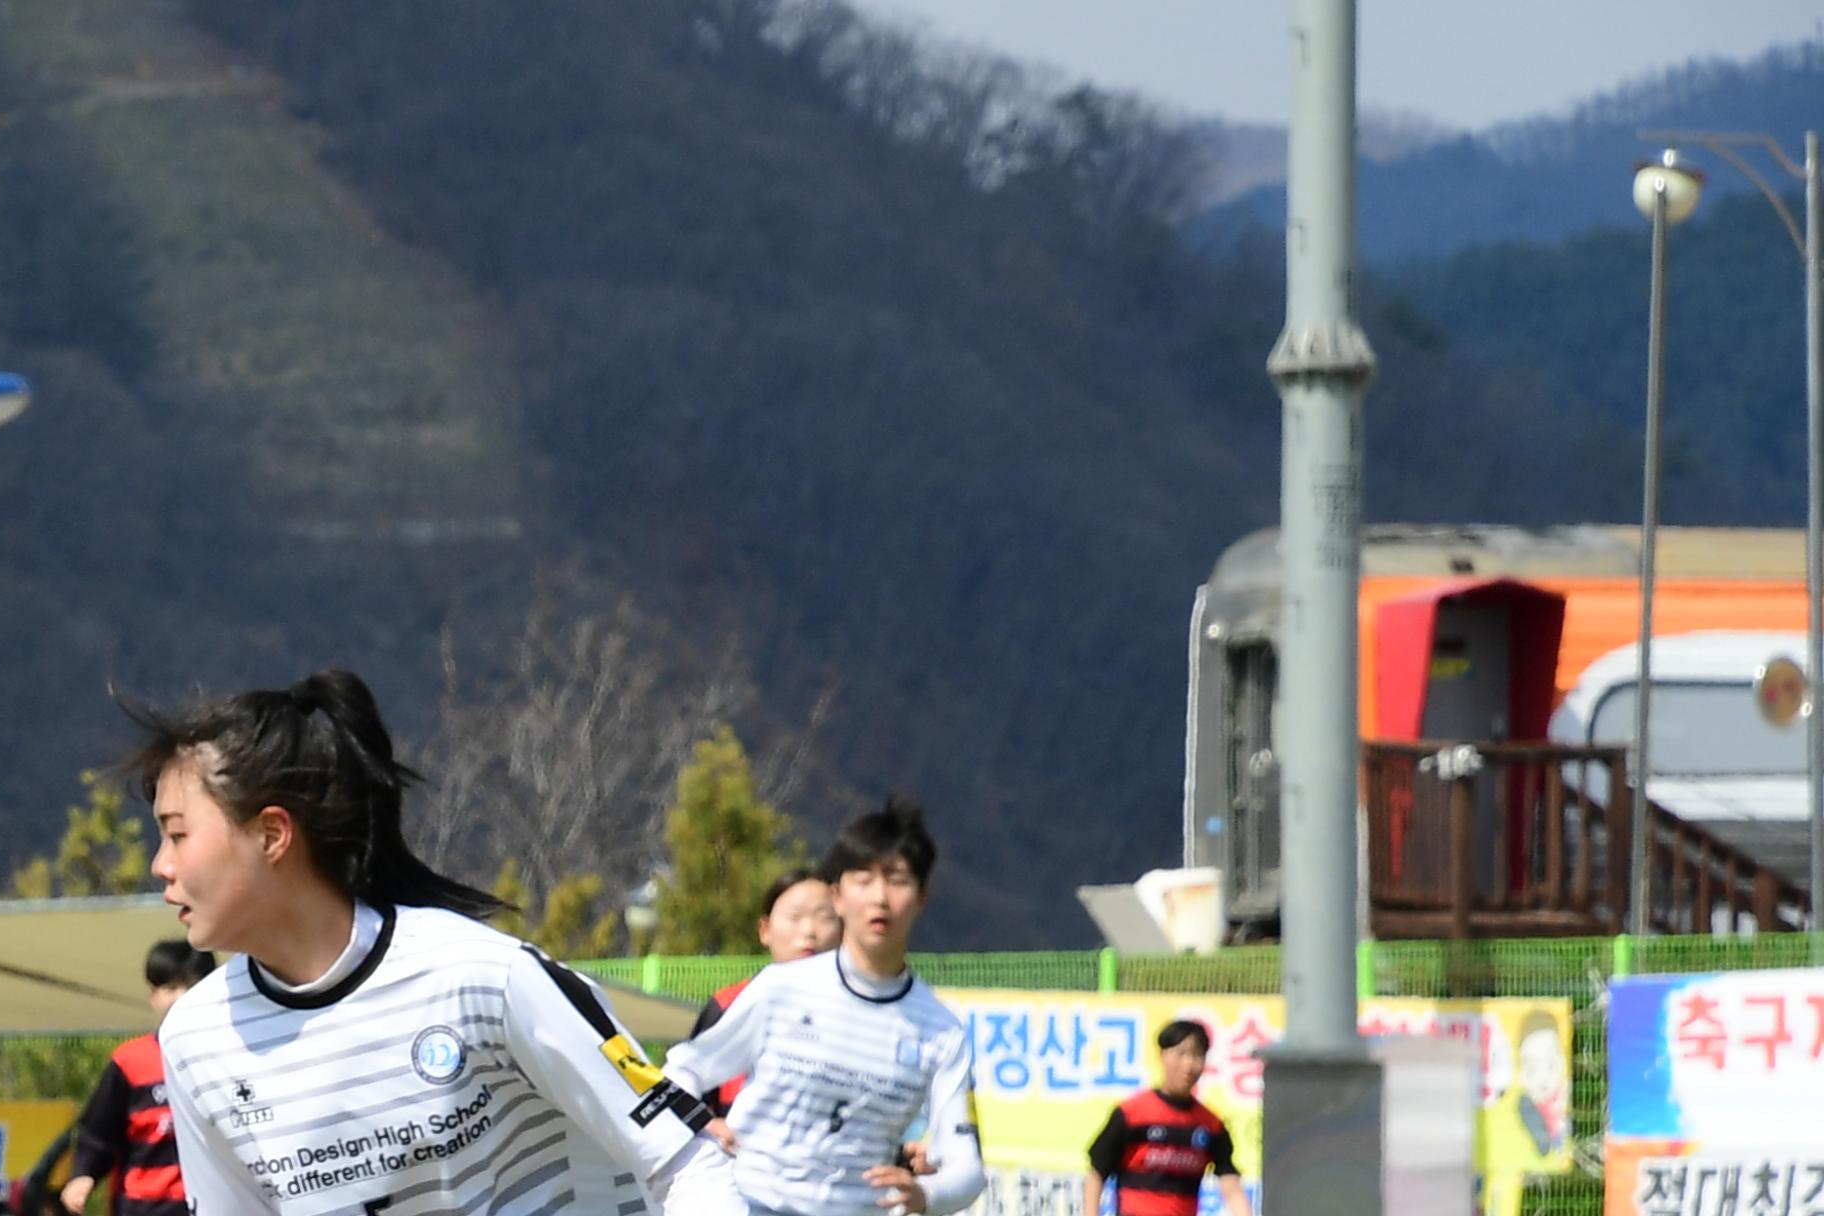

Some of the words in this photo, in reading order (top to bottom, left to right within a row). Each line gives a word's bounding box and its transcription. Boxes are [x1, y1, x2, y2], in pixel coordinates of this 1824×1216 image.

[968, 1011, 1141, 1092] 정산고
[287, 1160, 376, 1197] different
[379, 1152, 408, 1172] for
[413, 1114, 492, 1162] creation
[297, 1135, 372, 1168] Design
[375, 1120, 425, 1148] High
[428, 1084, 493, 1135] School
